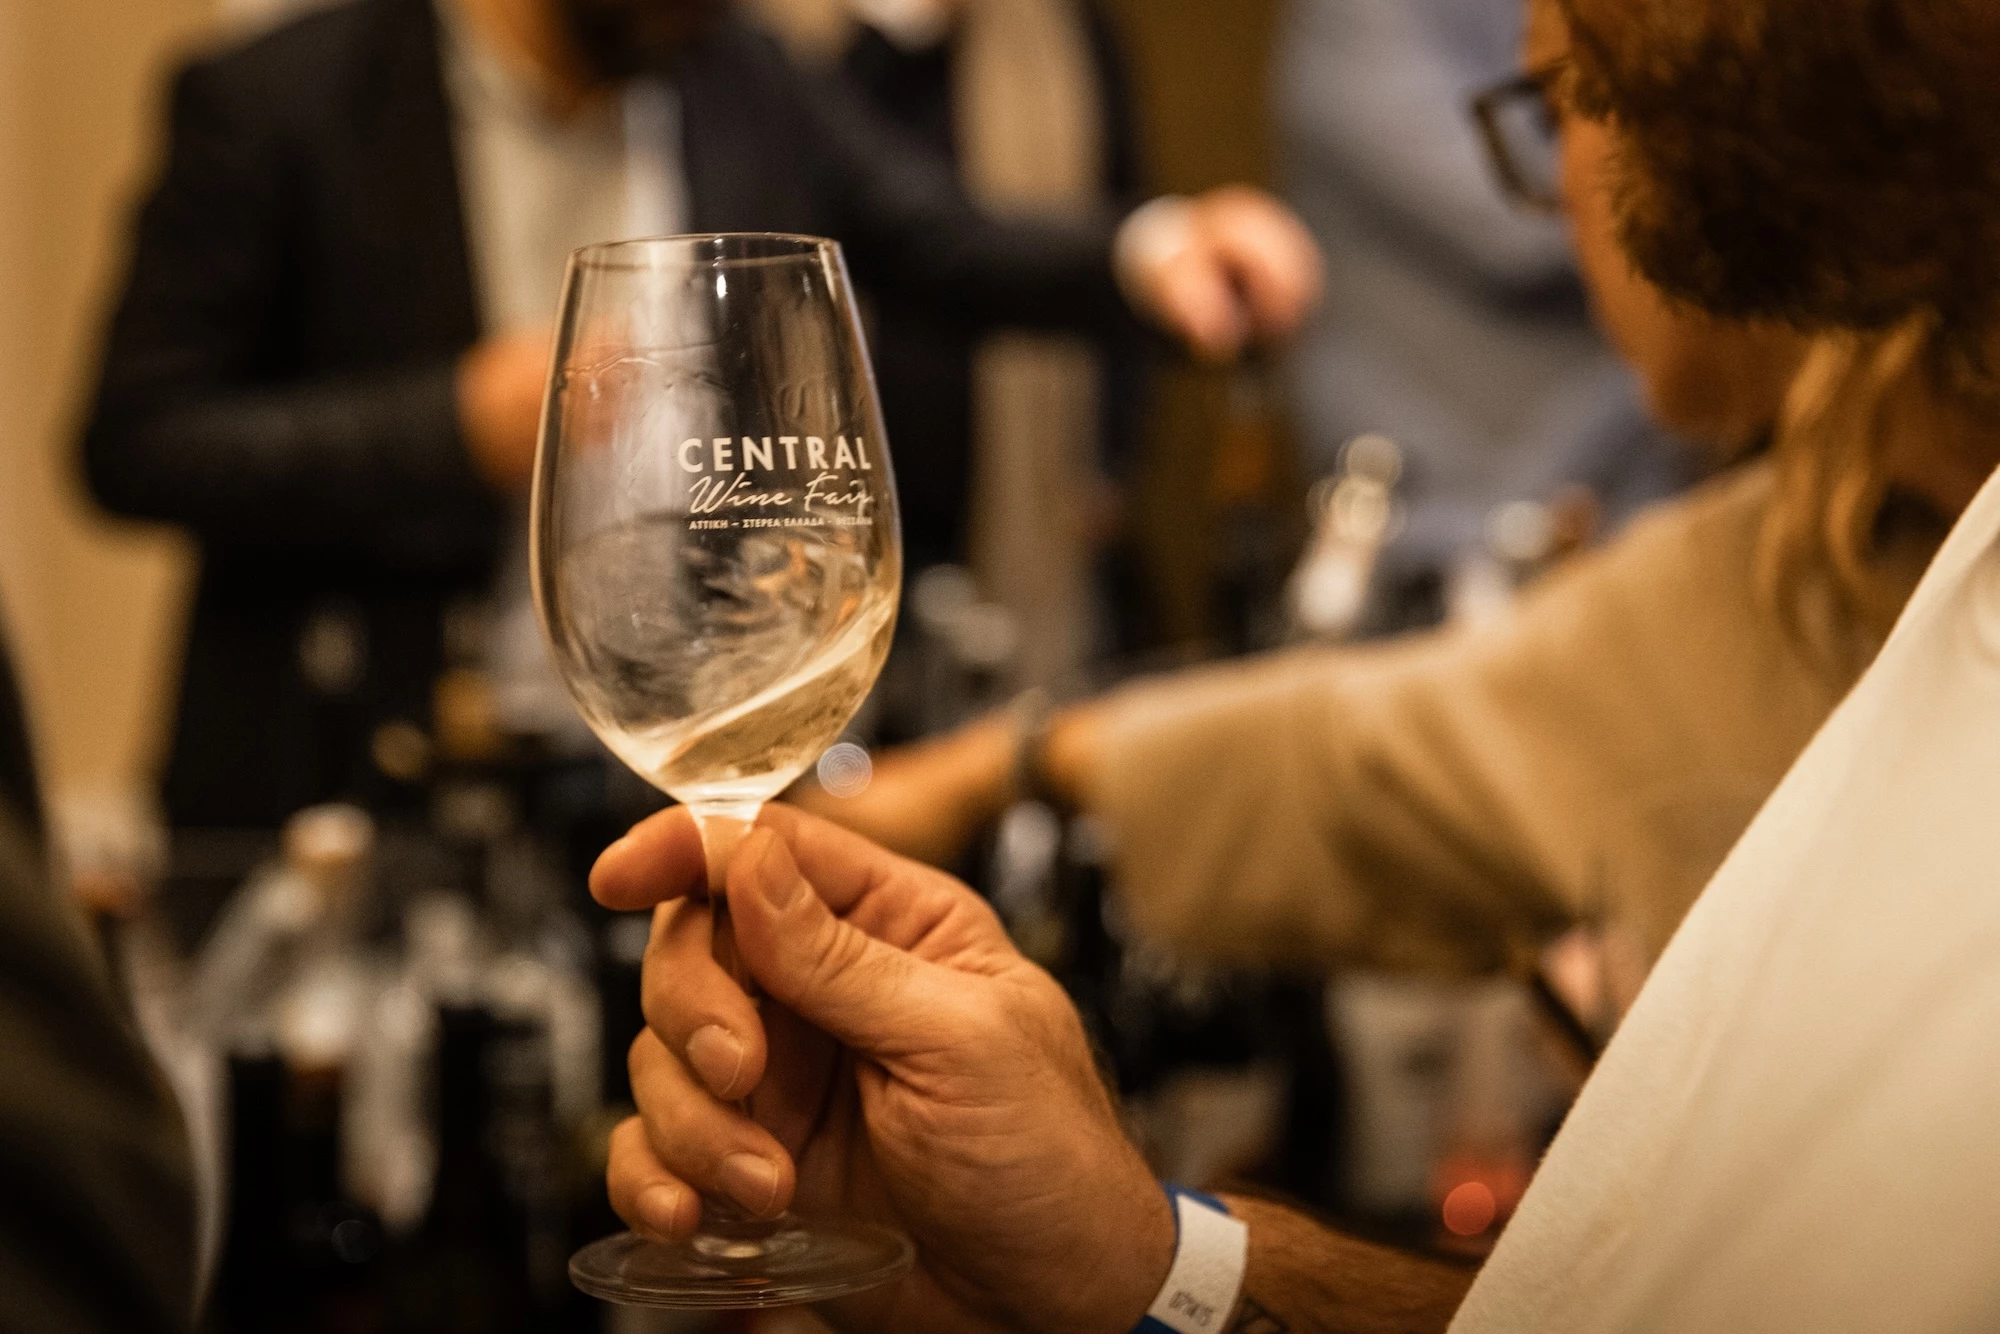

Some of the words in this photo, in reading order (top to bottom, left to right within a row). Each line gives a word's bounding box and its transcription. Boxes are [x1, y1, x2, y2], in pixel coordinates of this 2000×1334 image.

[678, 436, 872, 473] CENTRAL
[688, 472, 792, 514] Wine
[803, 472, 874, 513] Fair
[689, 519, 729, 530] ΑΤΤΙΚΗ
[742, 518, 781, 529] ΣΤΕΡΕΑ
